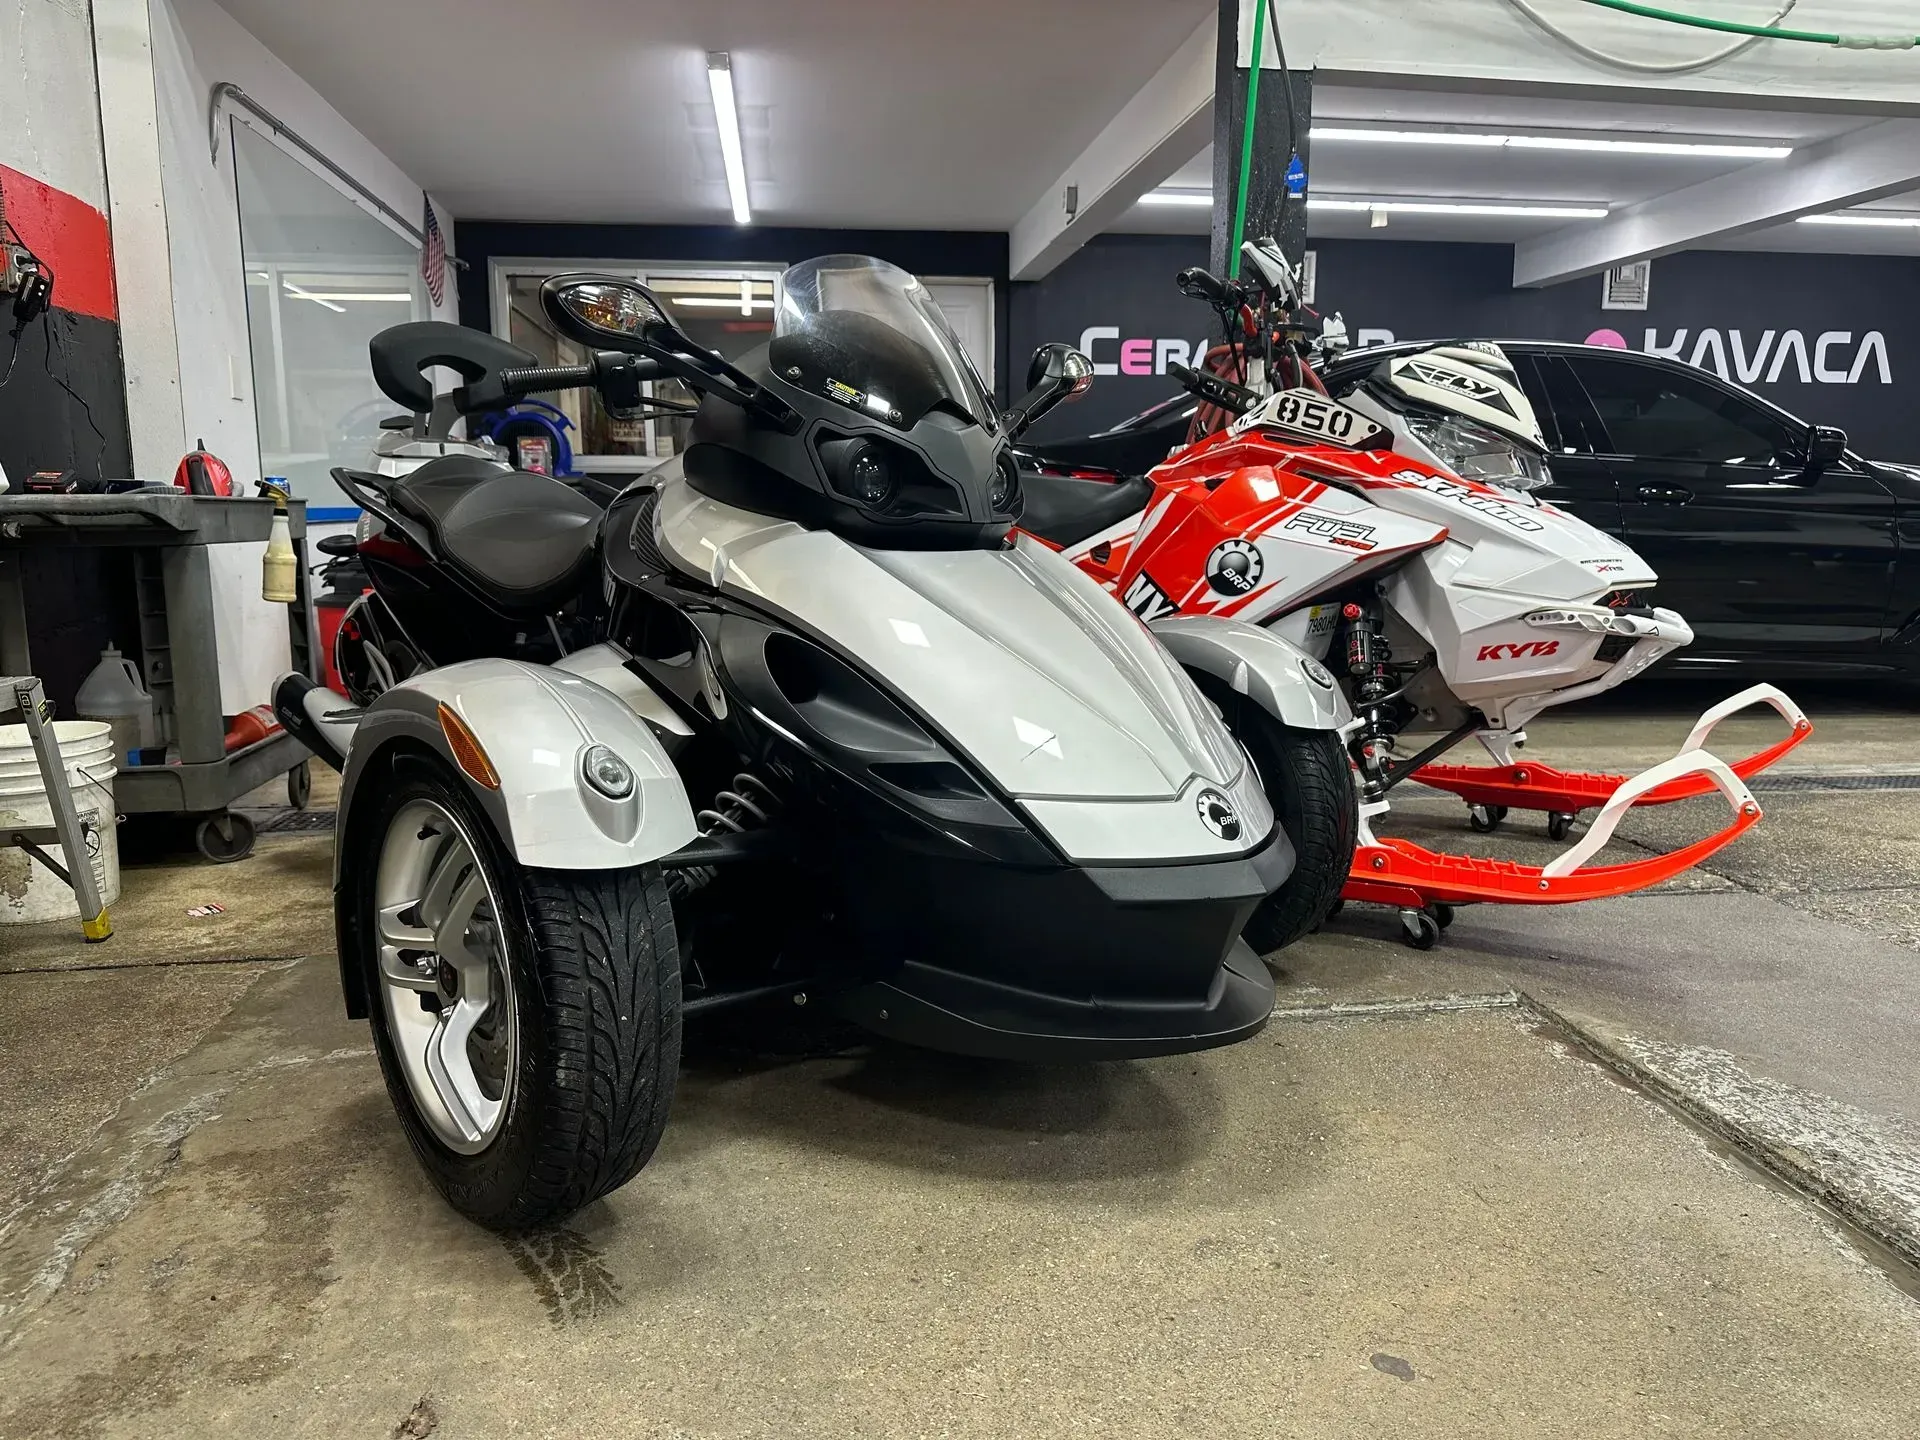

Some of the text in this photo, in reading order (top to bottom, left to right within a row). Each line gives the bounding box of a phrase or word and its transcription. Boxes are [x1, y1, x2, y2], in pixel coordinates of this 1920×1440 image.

[1643, 327, 1893, 384] KAVACA
[1431, 368, 1496, 396] FLY
[1276, 396, 1354, 438] 850
[1284, 513, 1379, 545] FUEL
[1222, 568, 1251, 591] BRP
[1595, 564, 1624, 573] XRS
[1124, 572, 1174, 625] NY
[1476, 640, 1560, 661] KYB
[1220, 815, 1238, 826] BRP
